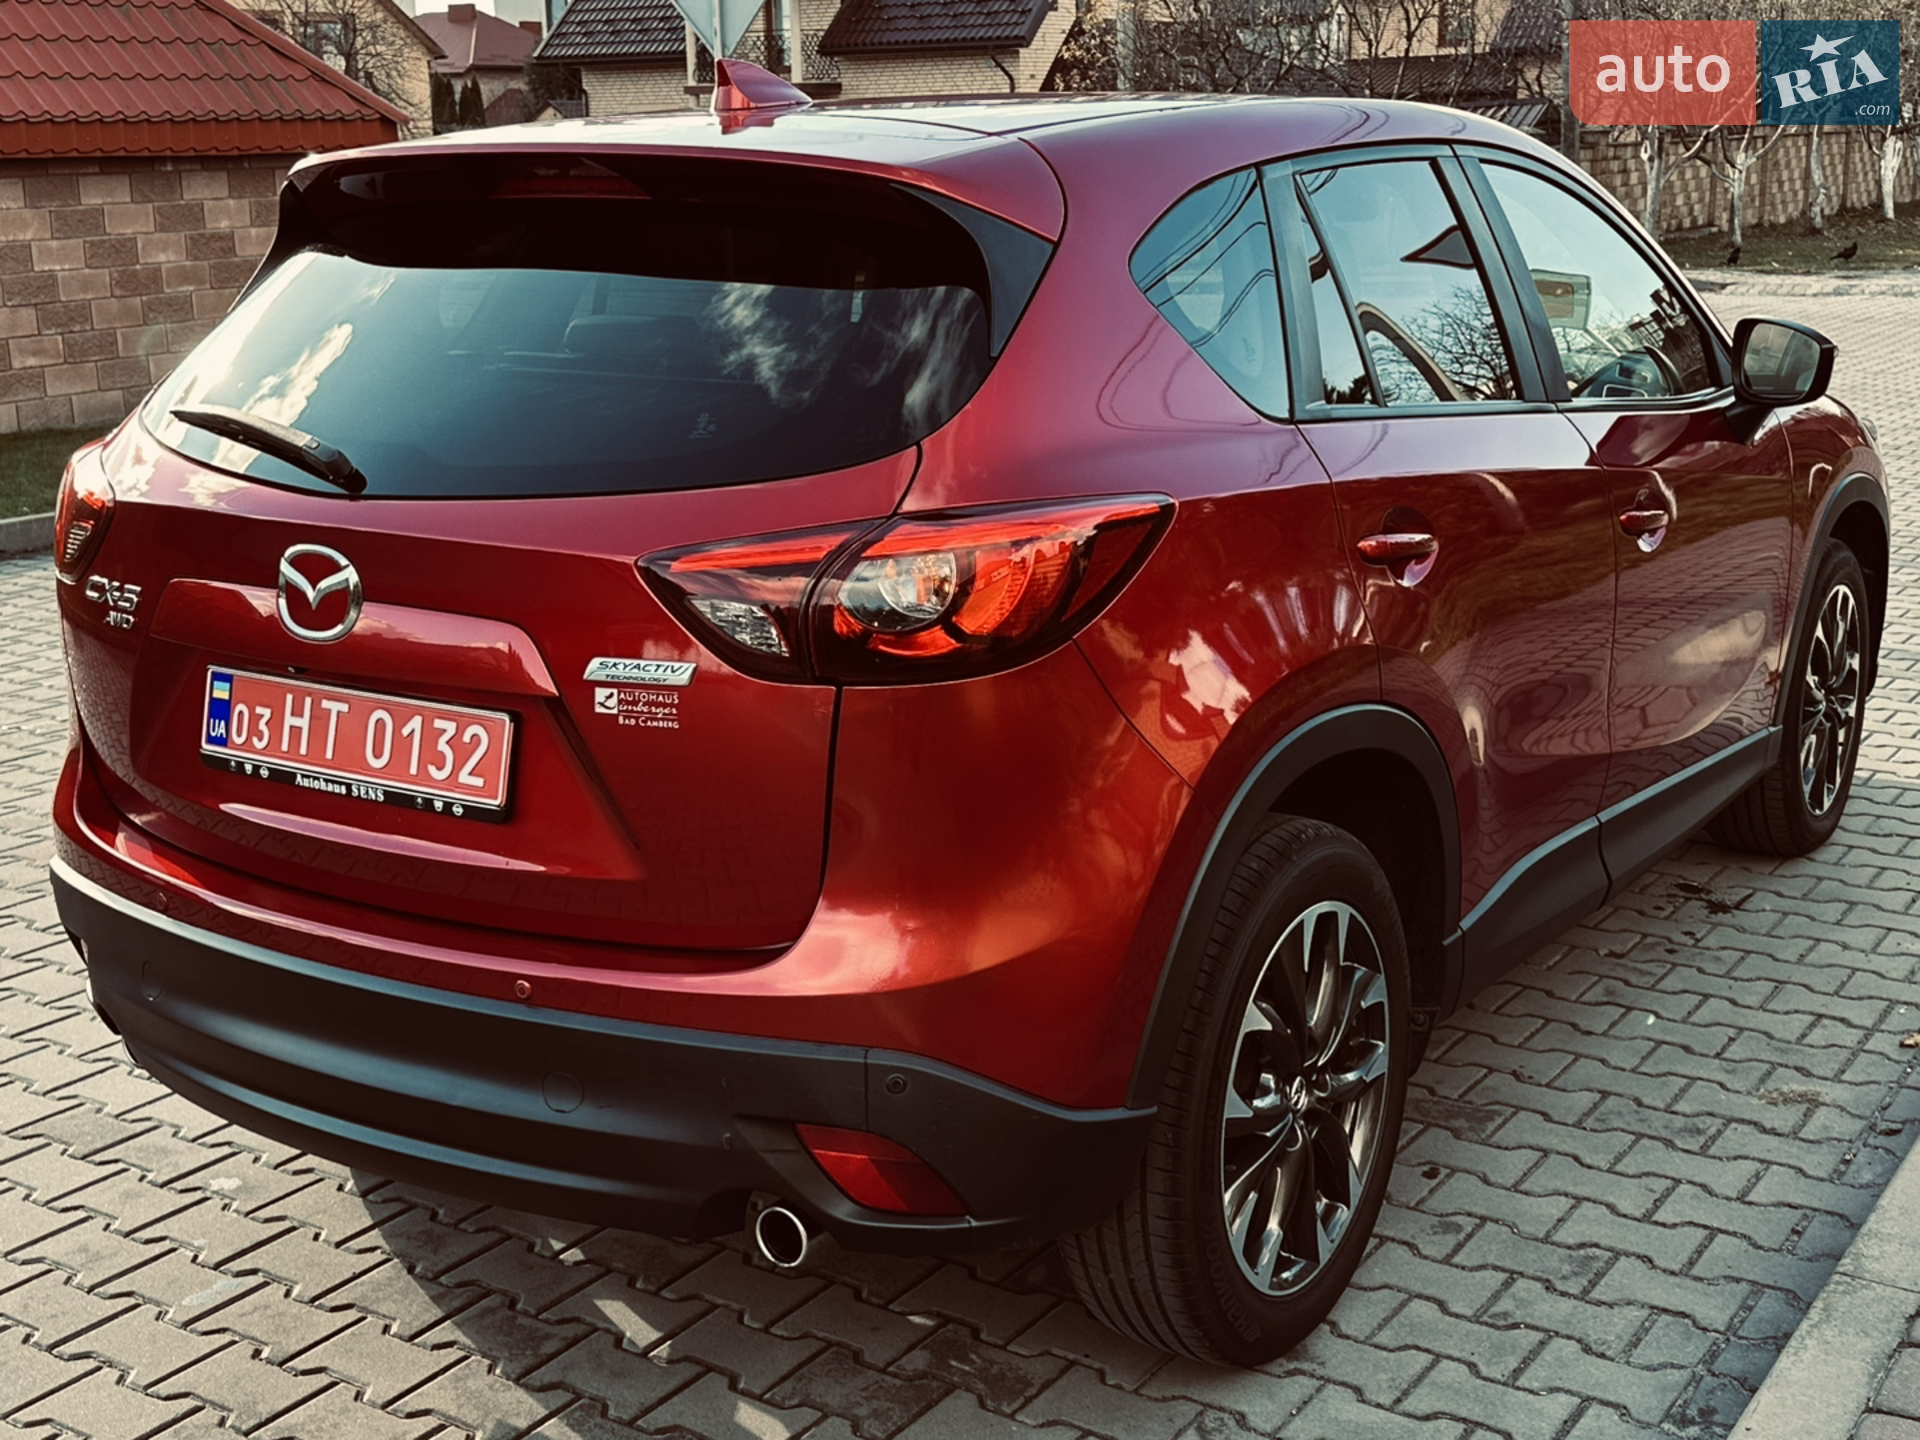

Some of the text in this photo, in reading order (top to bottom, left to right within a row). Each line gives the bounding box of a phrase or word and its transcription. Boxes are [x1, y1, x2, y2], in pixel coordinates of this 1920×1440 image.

[86, 575, 142, 611] CX-5
[103, 610, 135, 630] AWD
[598, 660, 683, 674] SKYACTIV
[605, 674, 668, 683] TECHNOLOGY
[618, 692, 679, 704] AUTOHAUS
[209, 718, 227, 738] UA
[231, 693, 490, 788] 03 HT 0132
[295, 773, 385, 802] Autohaus SENS
